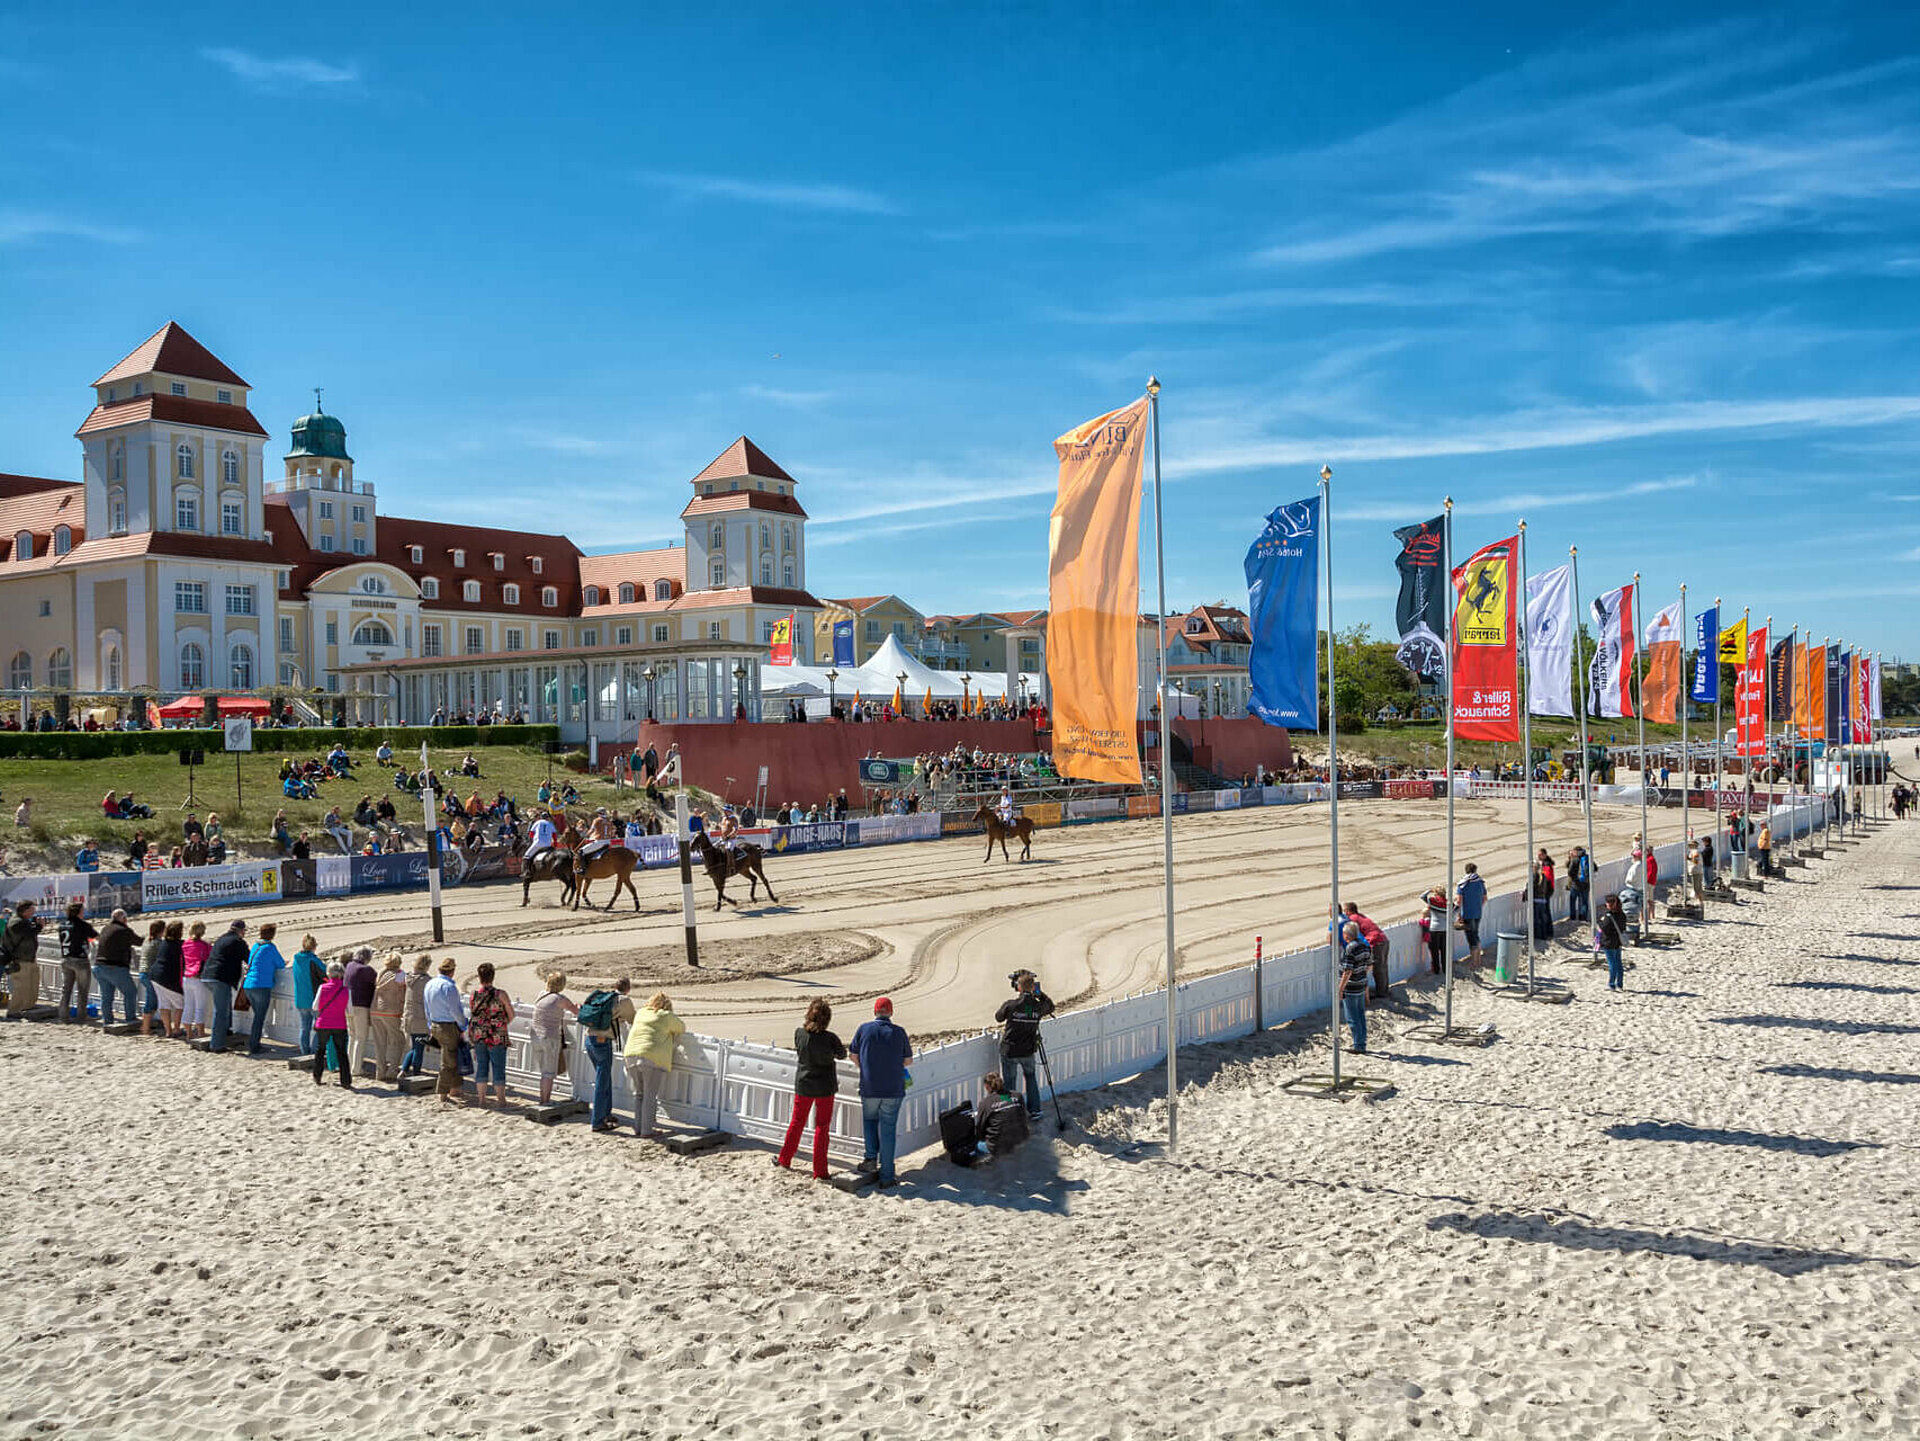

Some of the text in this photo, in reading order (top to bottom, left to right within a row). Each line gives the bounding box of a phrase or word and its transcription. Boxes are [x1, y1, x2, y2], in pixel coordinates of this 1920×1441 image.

[145, 884, 180, 897] Riller
[193, 876, 258, 893] Schnauck
[61, 930, 71, 946] 2
